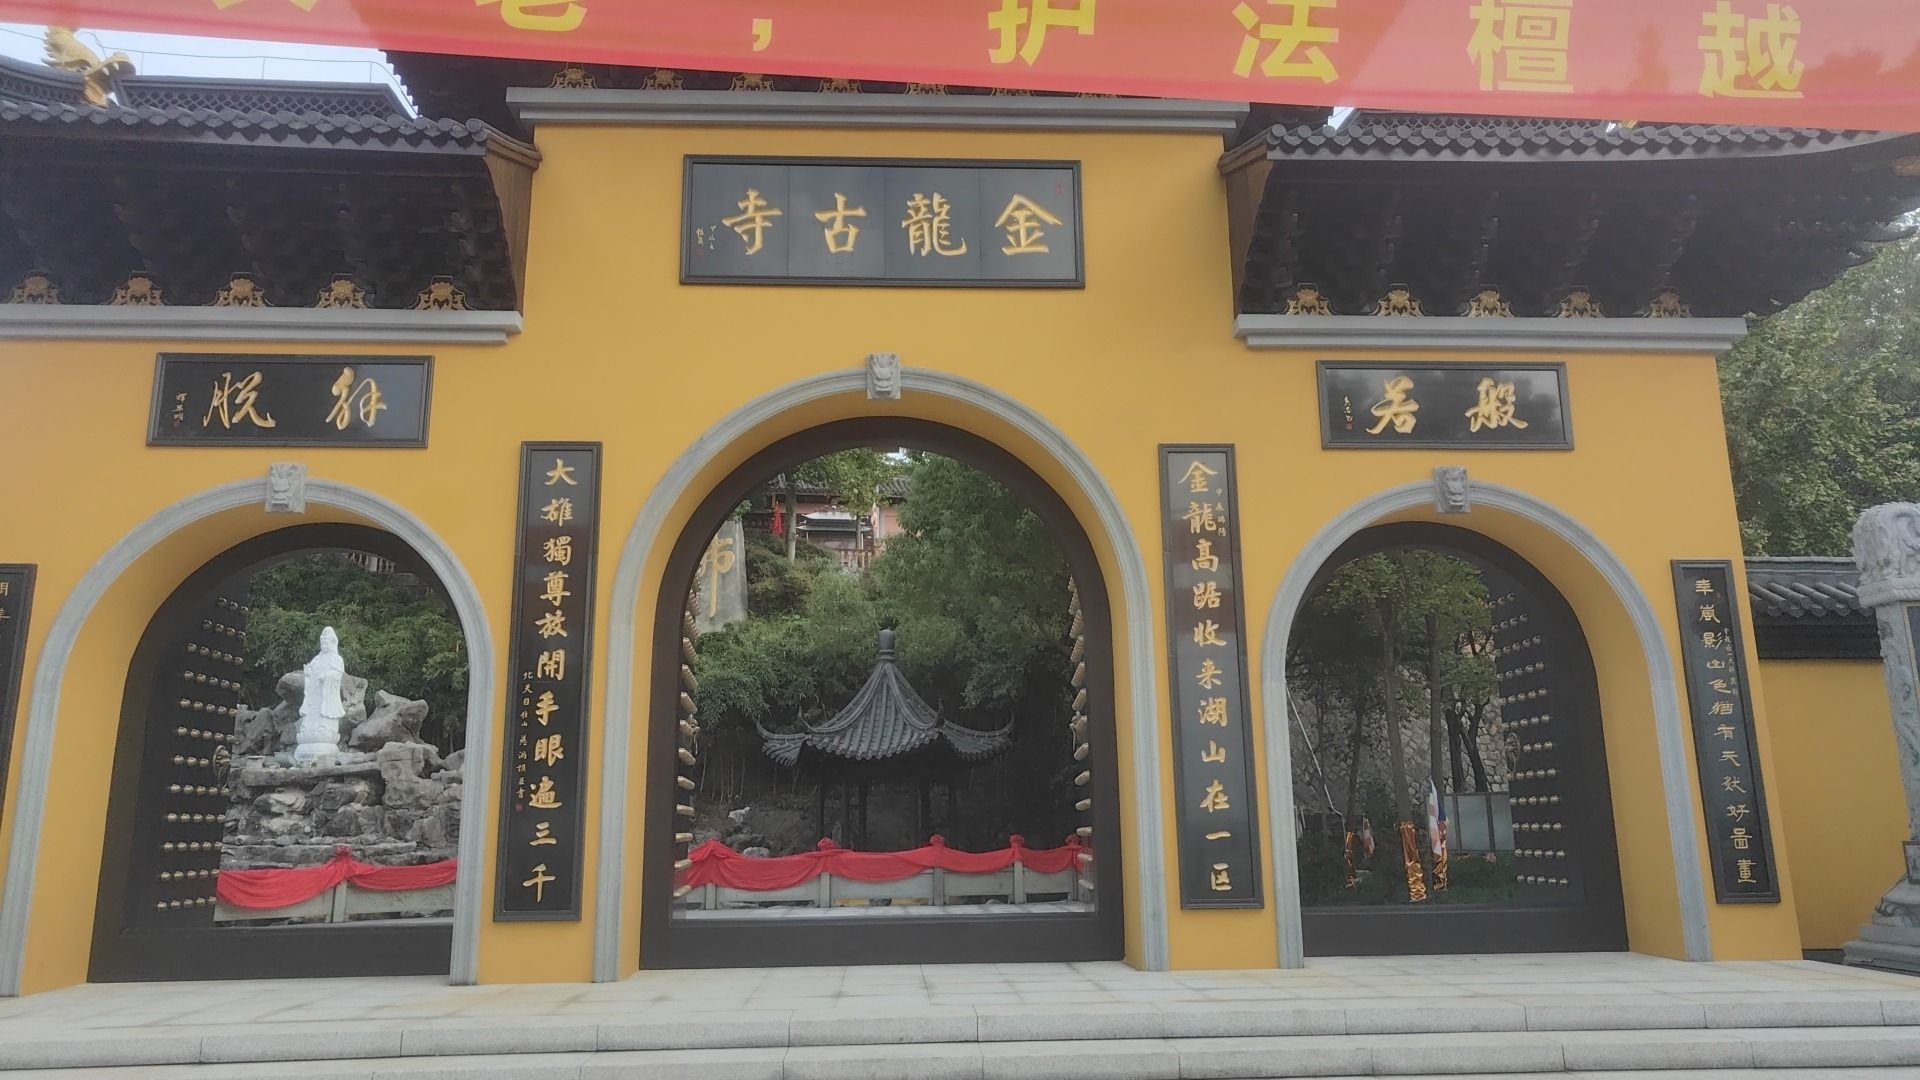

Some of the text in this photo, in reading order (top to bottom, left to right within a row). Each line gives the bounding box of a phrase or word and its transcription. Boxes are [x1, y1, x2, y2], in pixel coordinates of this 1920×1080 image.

[722, 189, 1063, 257] 金龍古寺
[1365, 375, 1529, 435] 般若
